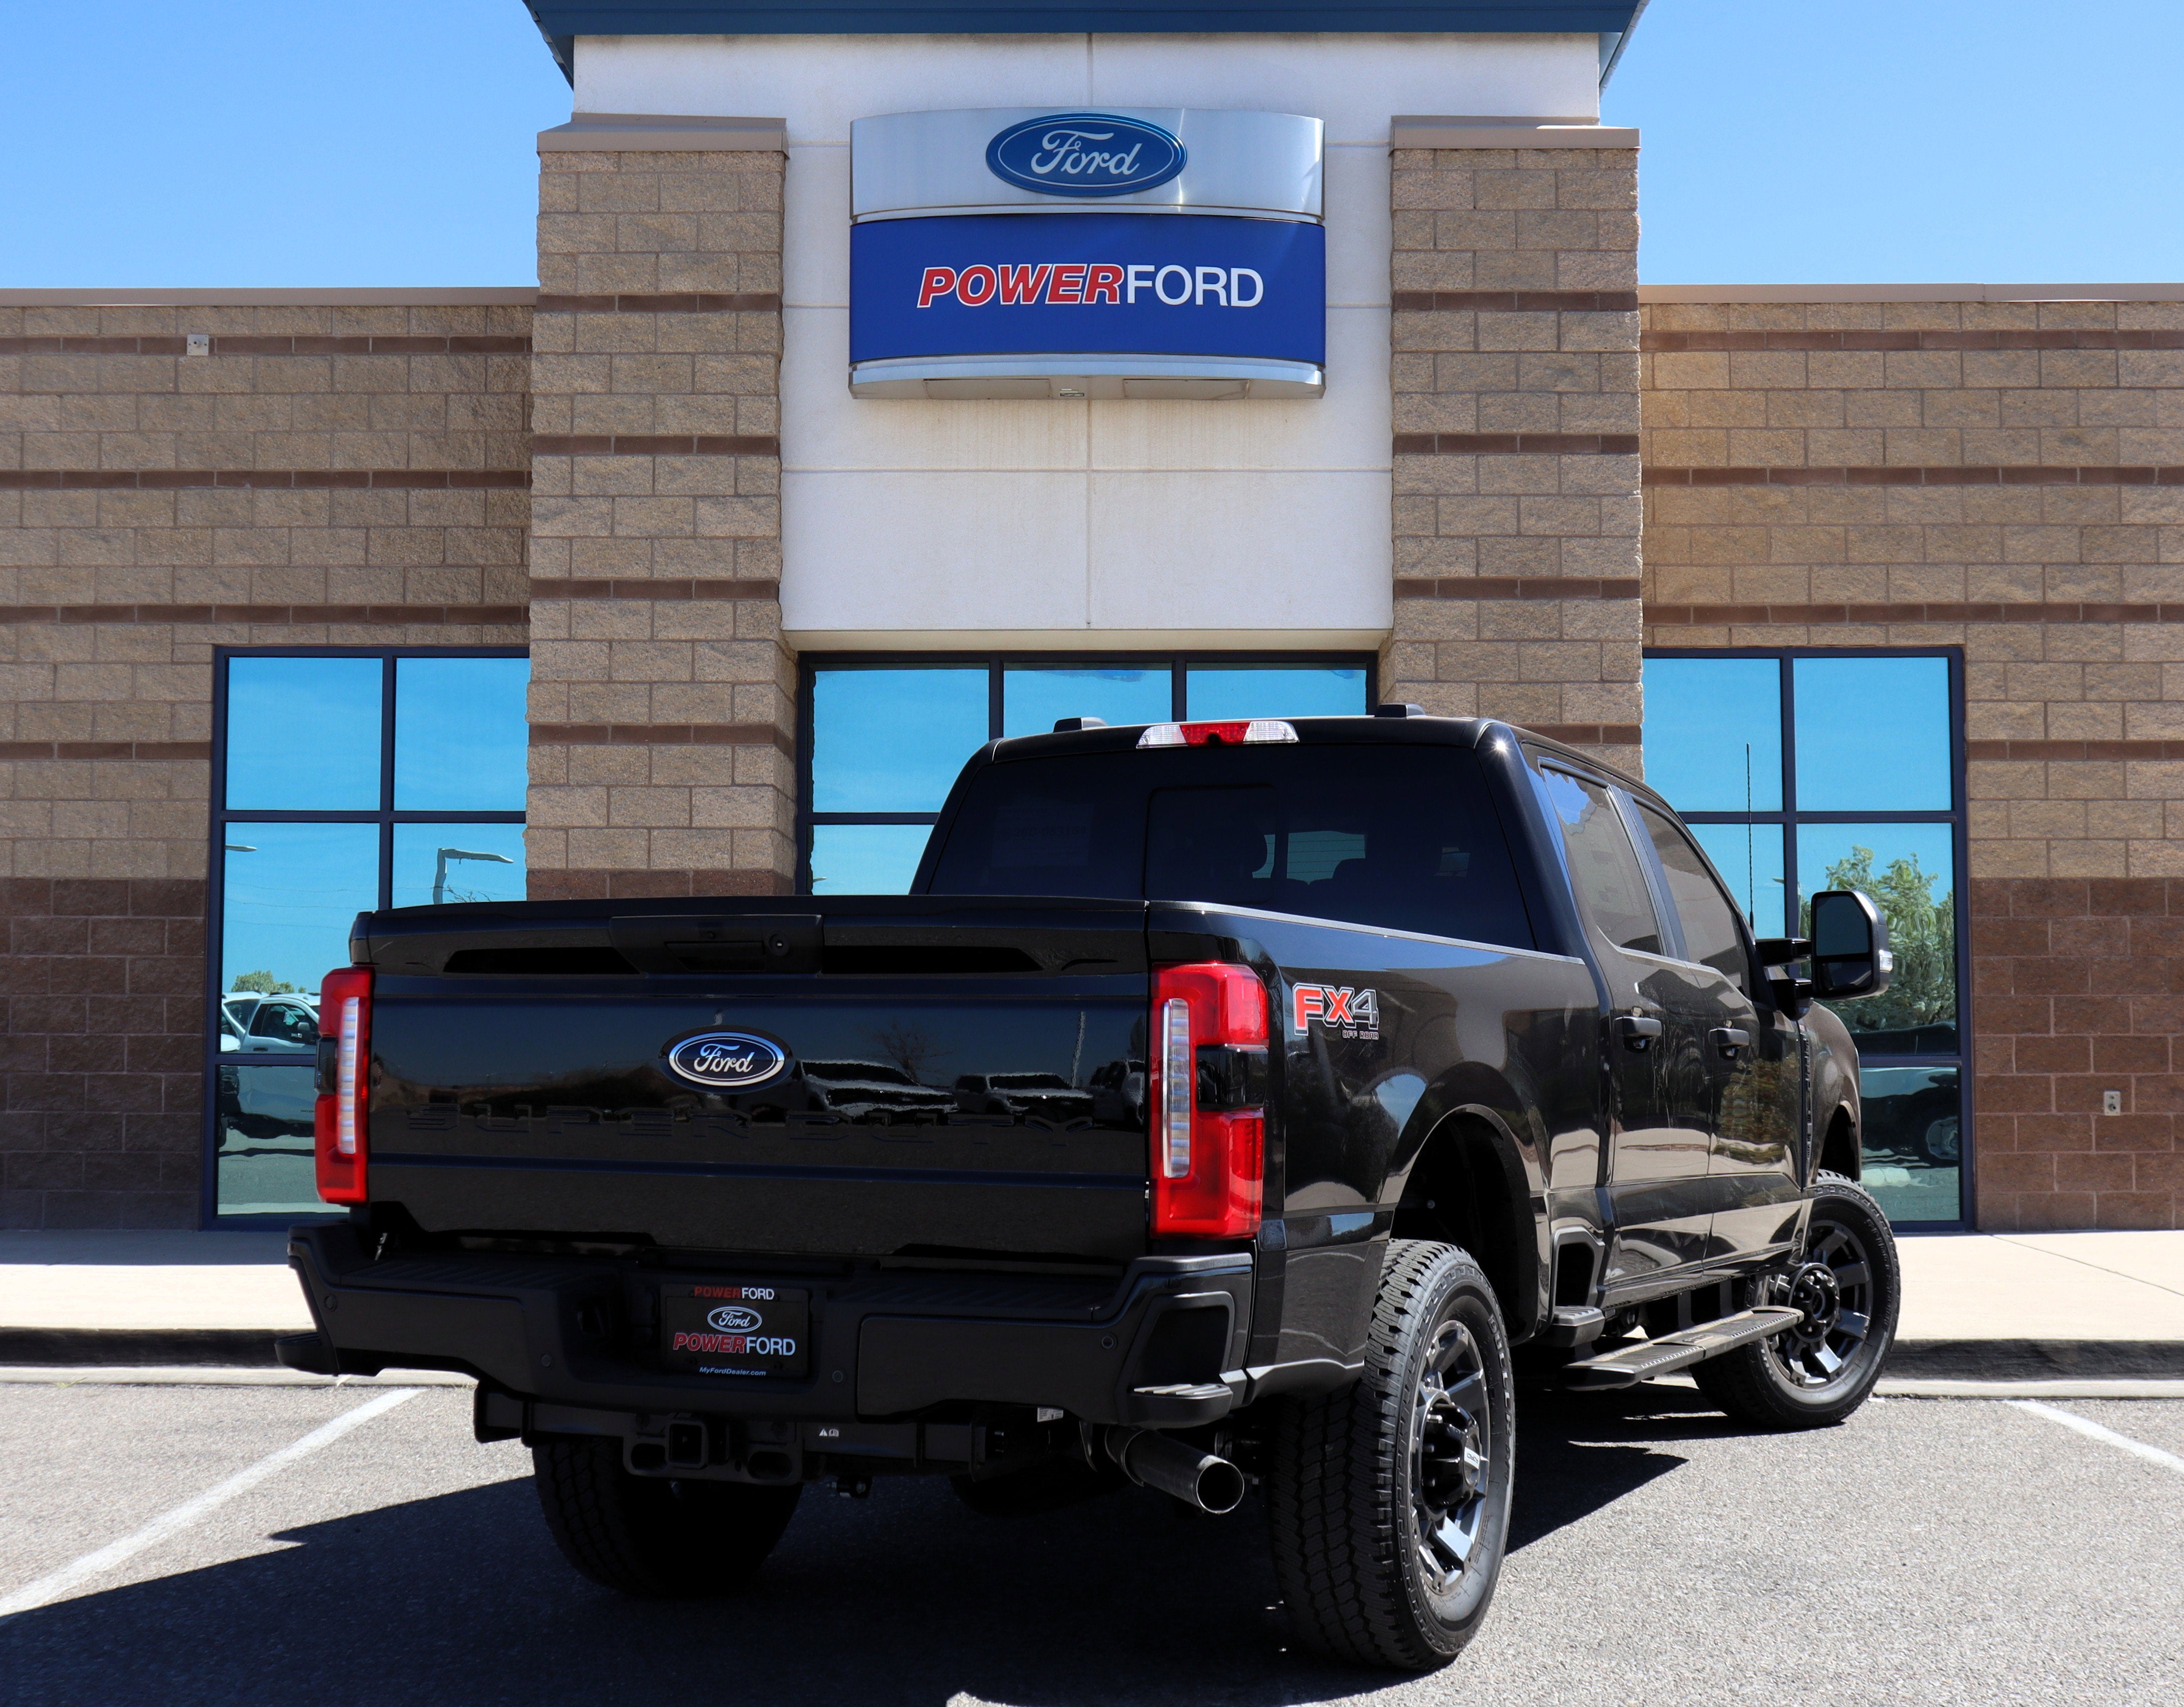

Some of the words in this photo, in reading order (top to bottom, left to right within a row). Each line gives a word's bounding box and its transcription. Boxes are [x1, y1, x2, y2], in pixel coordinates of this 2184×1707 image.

[1030, 129, 1143, 176] Ford
[916, 263, 1265, 308] POWERFORD
[1292, 982, 1379, 1036] FX4
[1342, 1029, 1358, 1039] OFF
[1359, 1030, 1379, 1040] ROAD
[693, 1043, 755, 1072] Ford
[408, 1103, 751, 1138] SUPER
[785, 1110, 1094, 1147] DUTY
[694, 1286, 774, 1300] POWERFORD
[718, 1310, 750, 1328] Ford
[673, 1333, 796, 1356] POWERFORD
[700, 1366, 766, 1376] MyFordDealer.com
